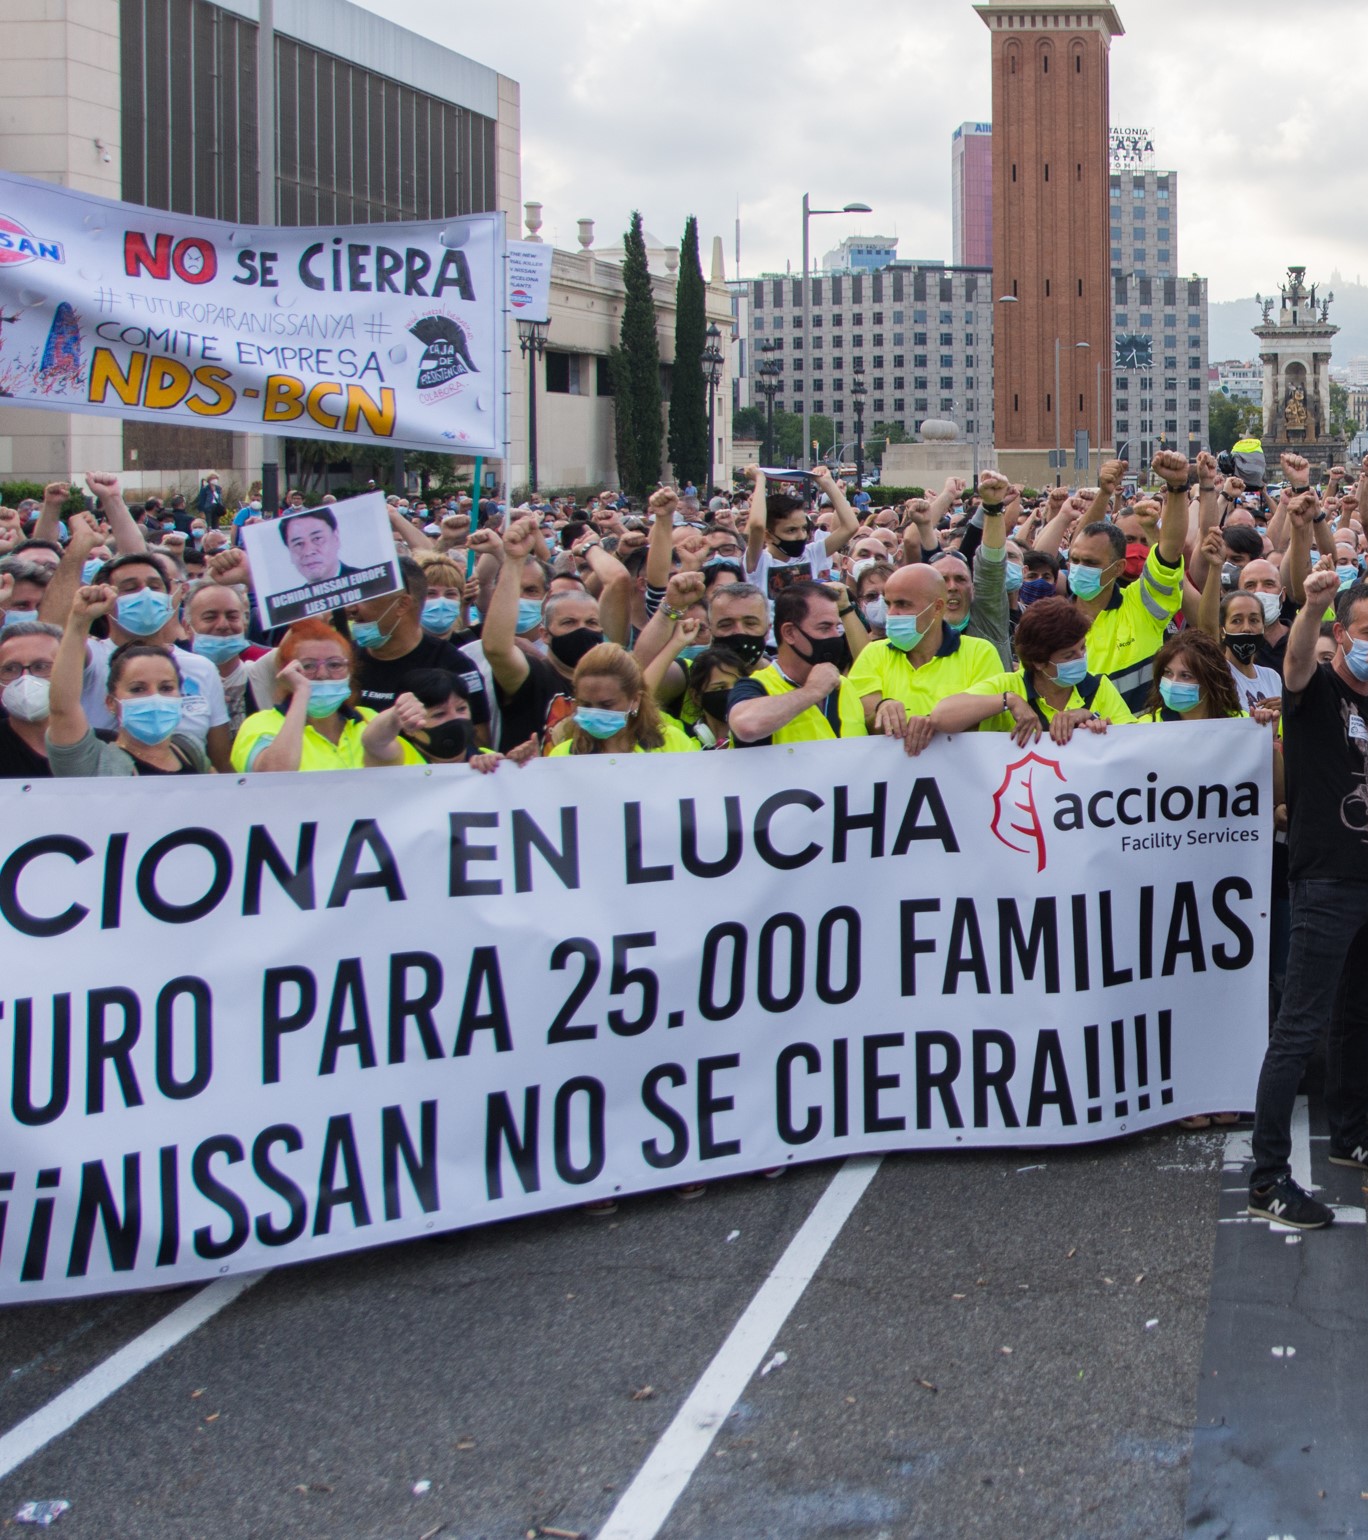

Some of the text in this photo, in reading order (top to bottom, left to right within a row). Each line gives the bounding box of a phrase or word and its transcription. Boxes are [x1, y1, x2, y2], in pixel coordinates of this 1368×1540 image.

[124, 230, 218, 284] NO
[233, 252, 278, 287] SE
[236, 342, 385, 382] EMPRESA
[429, 344, 454, 355] CAJA
[439, 356, 454, 365] DE
[87, 346, 396, 437] NDS-BCN
[420, 364, 467, 385] RESISTENCIA
[272, 566, 387, 608] UCHIDA NISSAN EUROPE
[305, 588, 363, 614] LIES TO YOU
[1053, 771, 1260, 831] acciona
[0, 777, 961, 938] CIONA EN LUCHA
[1122, 828, 1260, 852] Facility Services
[0, 876, 1254, 1127] URO PARA 25.000 FAMILIAS
[485, 1075, 606, 1201] NO
[641, 1053, 742, 1169] SE
[775, 1009, 1174, 1145] CIERRA!!!!
